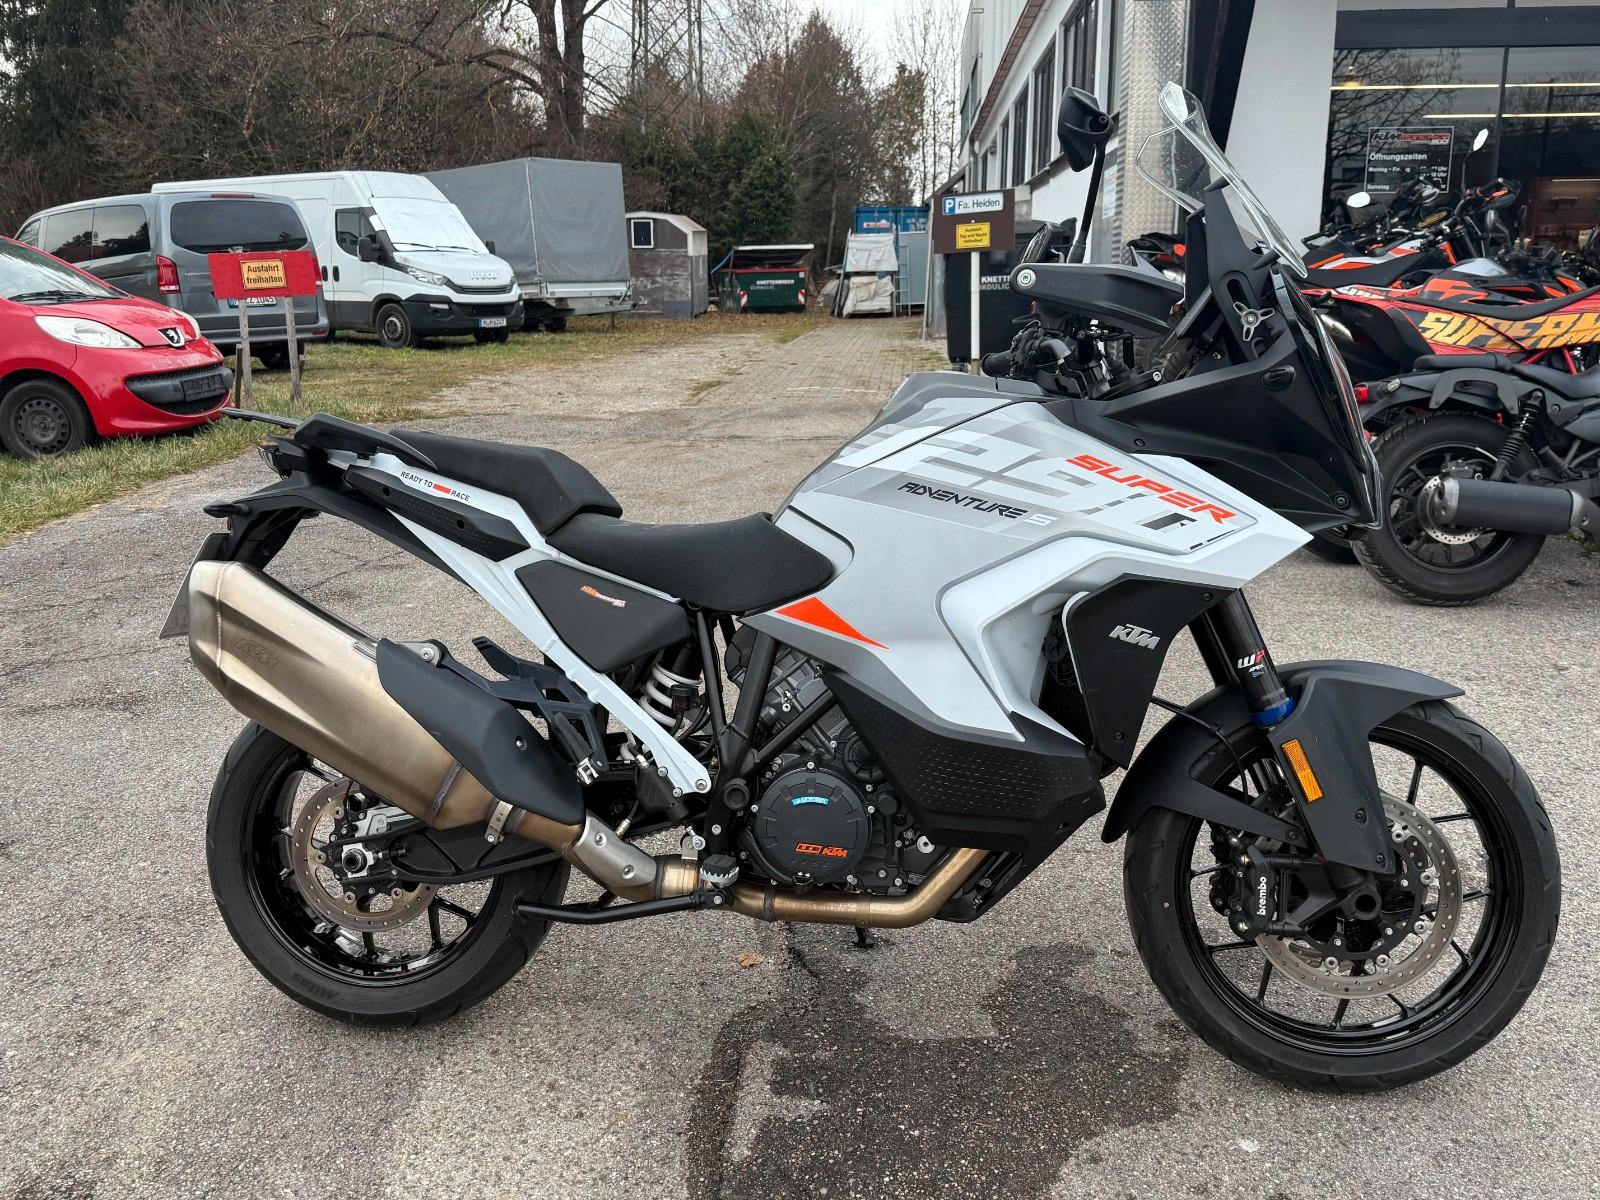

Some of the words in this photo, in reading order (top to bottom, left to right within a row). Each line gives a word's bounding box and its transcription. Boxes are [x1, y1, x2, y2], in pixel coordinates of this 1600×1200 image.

[1369, 152, 1427, 162] Öffnungszeiten
[958, 201, 970, 210] Fa.
[972, 198, 1001, 208] Heiden
[247, 264, 280, 273] Ausfahrt
[470, 272, 498, 280] IVECO
[246, 275, 283, 285] freihalten
[401, 471, 424, 484] READY
[424, 480, 433, 488] TO
[451, 489, 471, 501] RACE
[1063, 454, 1237, 525] SUPER
[897, 481, 1028, 519] ADVENTURE
[1024, 513, 1059, 526] S
[1108, 623, 1160, 650] KTM
[1237, 649, 1265, 668] WP
[1256, 876, 1267, 916] brembo
